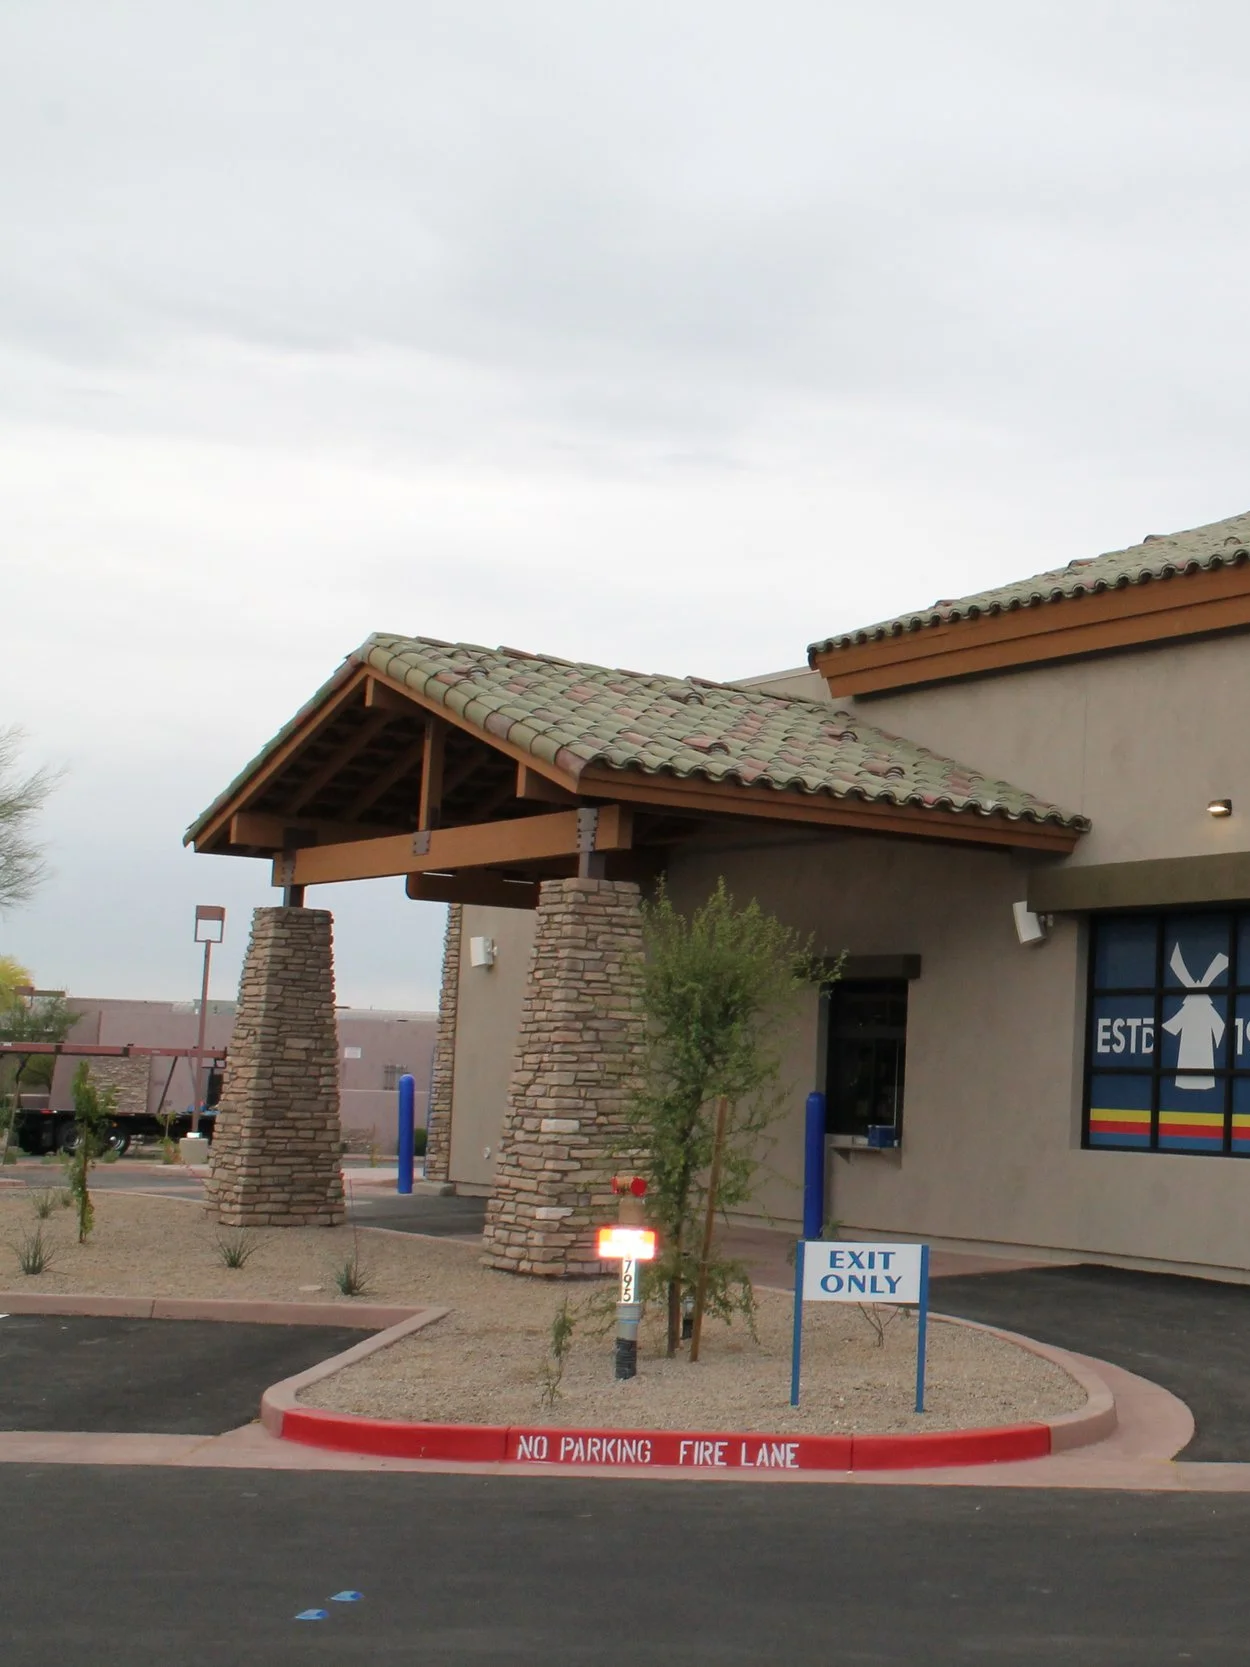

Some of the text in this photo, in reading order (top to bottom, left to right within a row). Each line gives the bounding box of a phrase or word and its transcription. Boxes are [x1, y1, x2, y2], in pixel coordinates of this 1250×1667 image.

[829, 1251, 896, 1269] EXIT
[821, 1274, 902, 1294] ONLY
[517, 1435, 800, 1468] NO PARKING FIRE LANE
